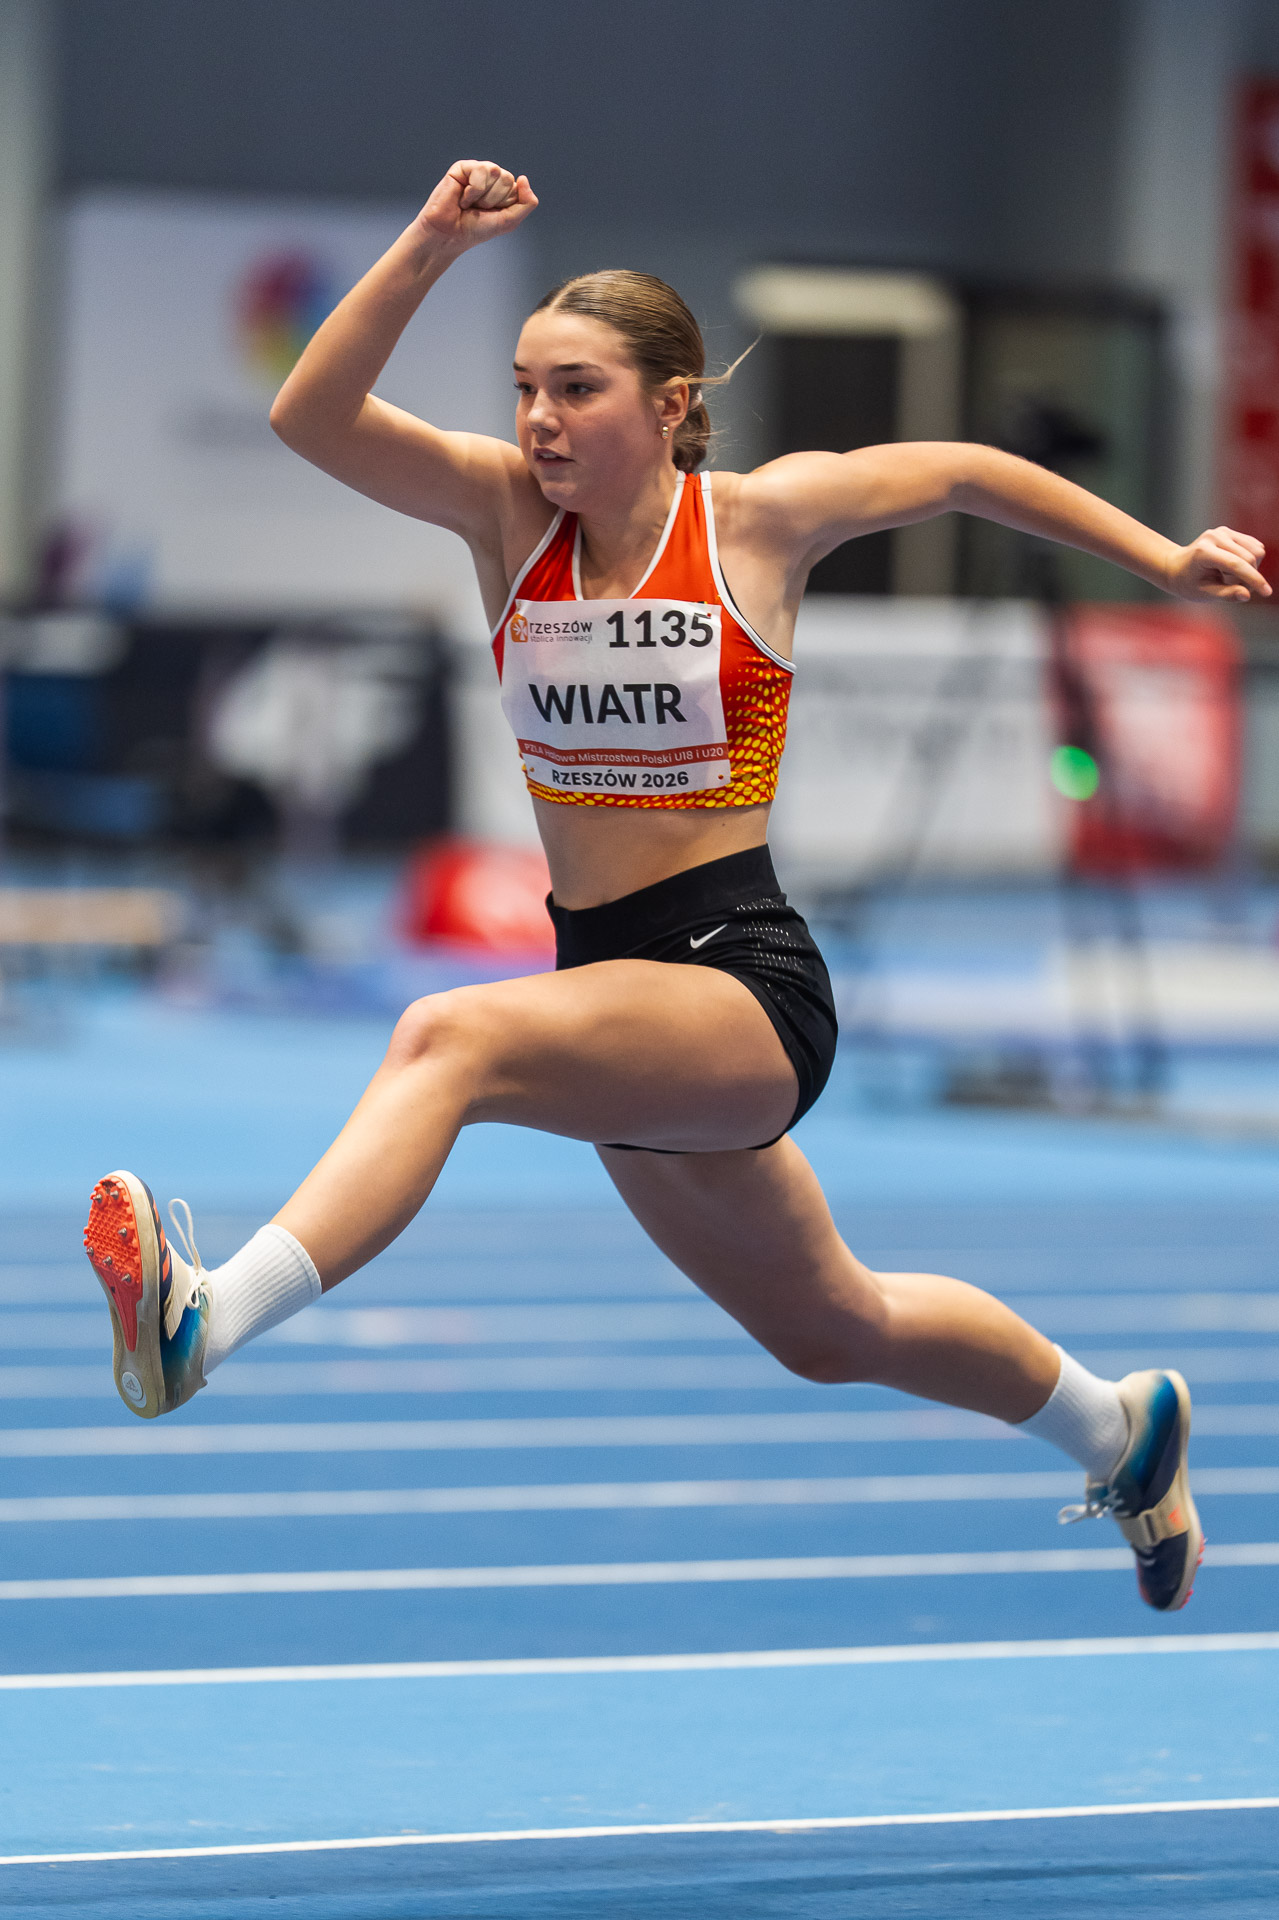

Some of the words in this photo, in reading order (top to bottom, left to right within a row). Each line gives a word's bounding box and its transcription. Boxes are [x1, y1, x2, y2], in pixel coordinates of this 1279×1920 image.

[529, 620, 593, 634] rzeszów
[606, 610, 713, 648] 1135
[556, 634, 593, 644] innowacji
[528, 683, 688, 725] WIATR
[524, 743, 544, 755] PZLA
[577, 752, 640, 763] Mistrzostwa
[642, 753, 672, 764] Polski
[674, 750, 693, 762] U18
[702, 747, 724, 758] U20
[552, 769, 637, 788] RZESZÓW
[641, 771, 689, 788] 2026
